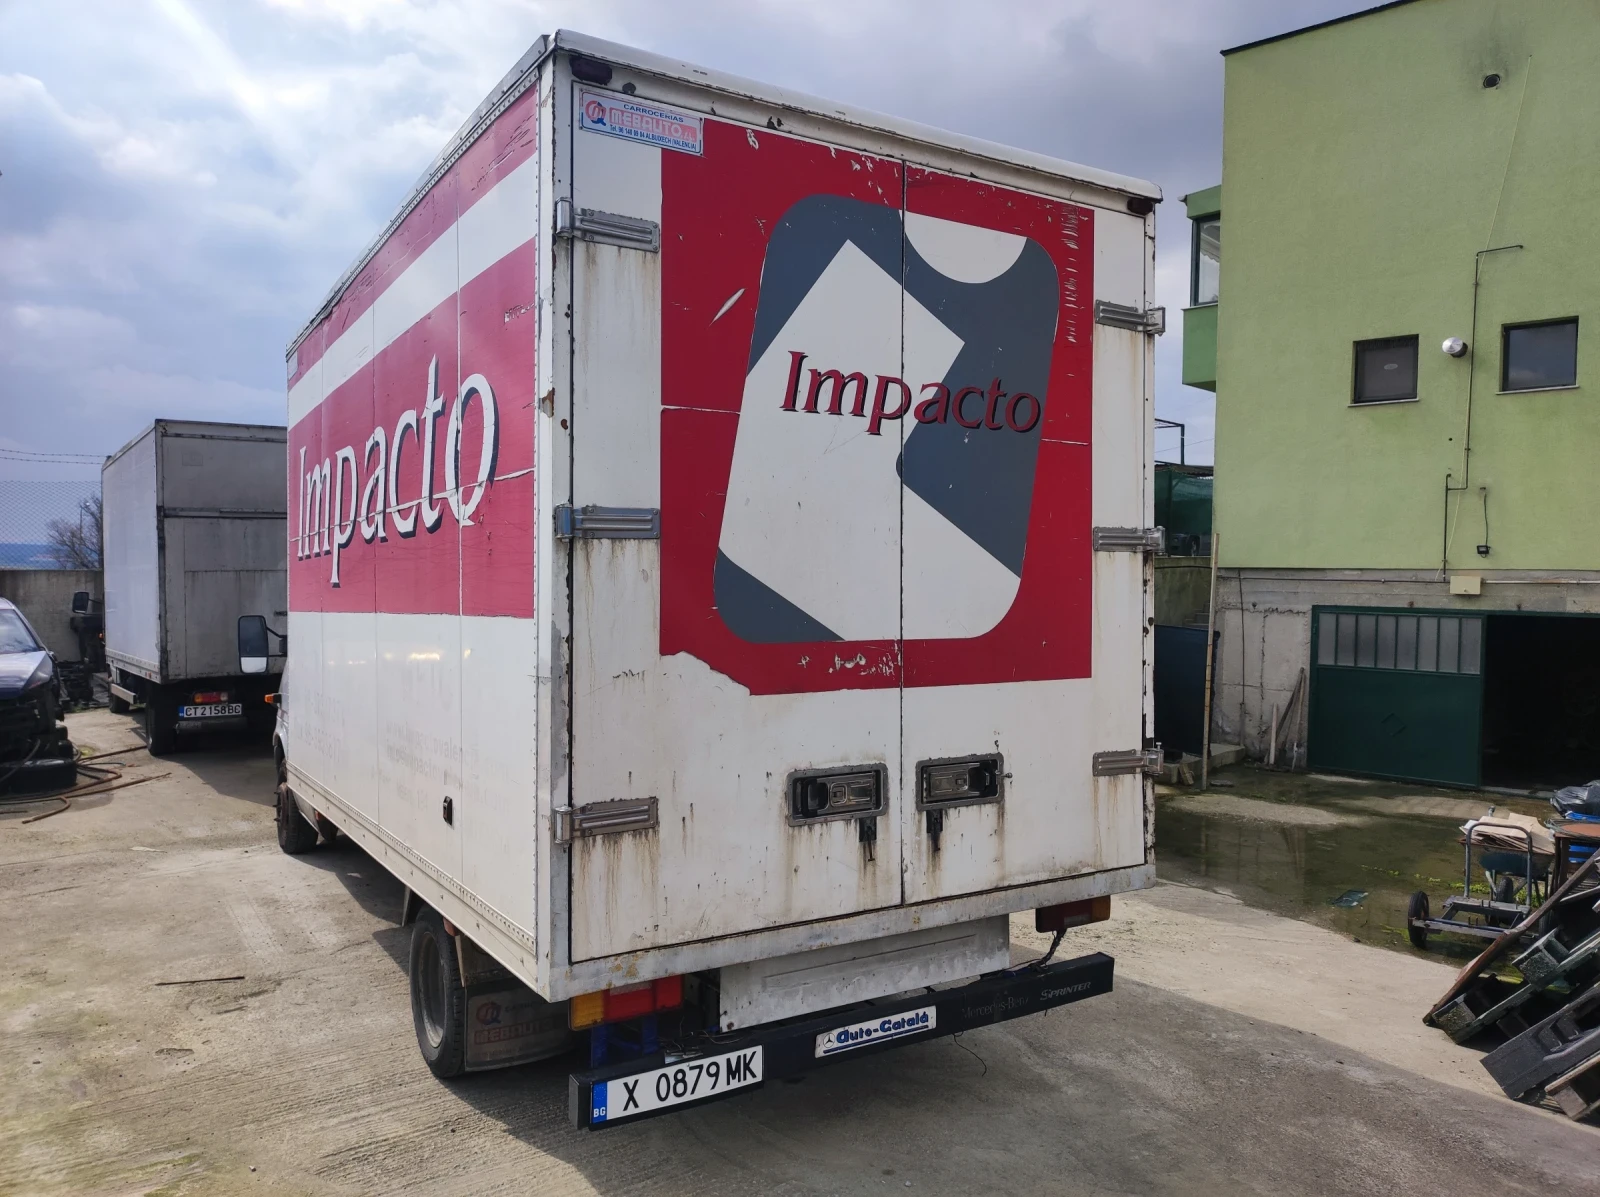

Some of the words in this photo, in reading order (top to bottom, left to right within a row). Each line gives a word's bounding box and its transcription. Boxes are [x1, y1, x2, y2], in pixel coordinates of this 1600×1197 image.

[623, 104, 684, 123] CARROCERIAS
[779, 350, 1042, 436] Impacto
[297, 353, 499, 588] Impacto
[1040, 981, 1092, 1001] SPRINTER
[622, 1079, 640, 1112] X
[593, 1106, 606, 1118] BG
